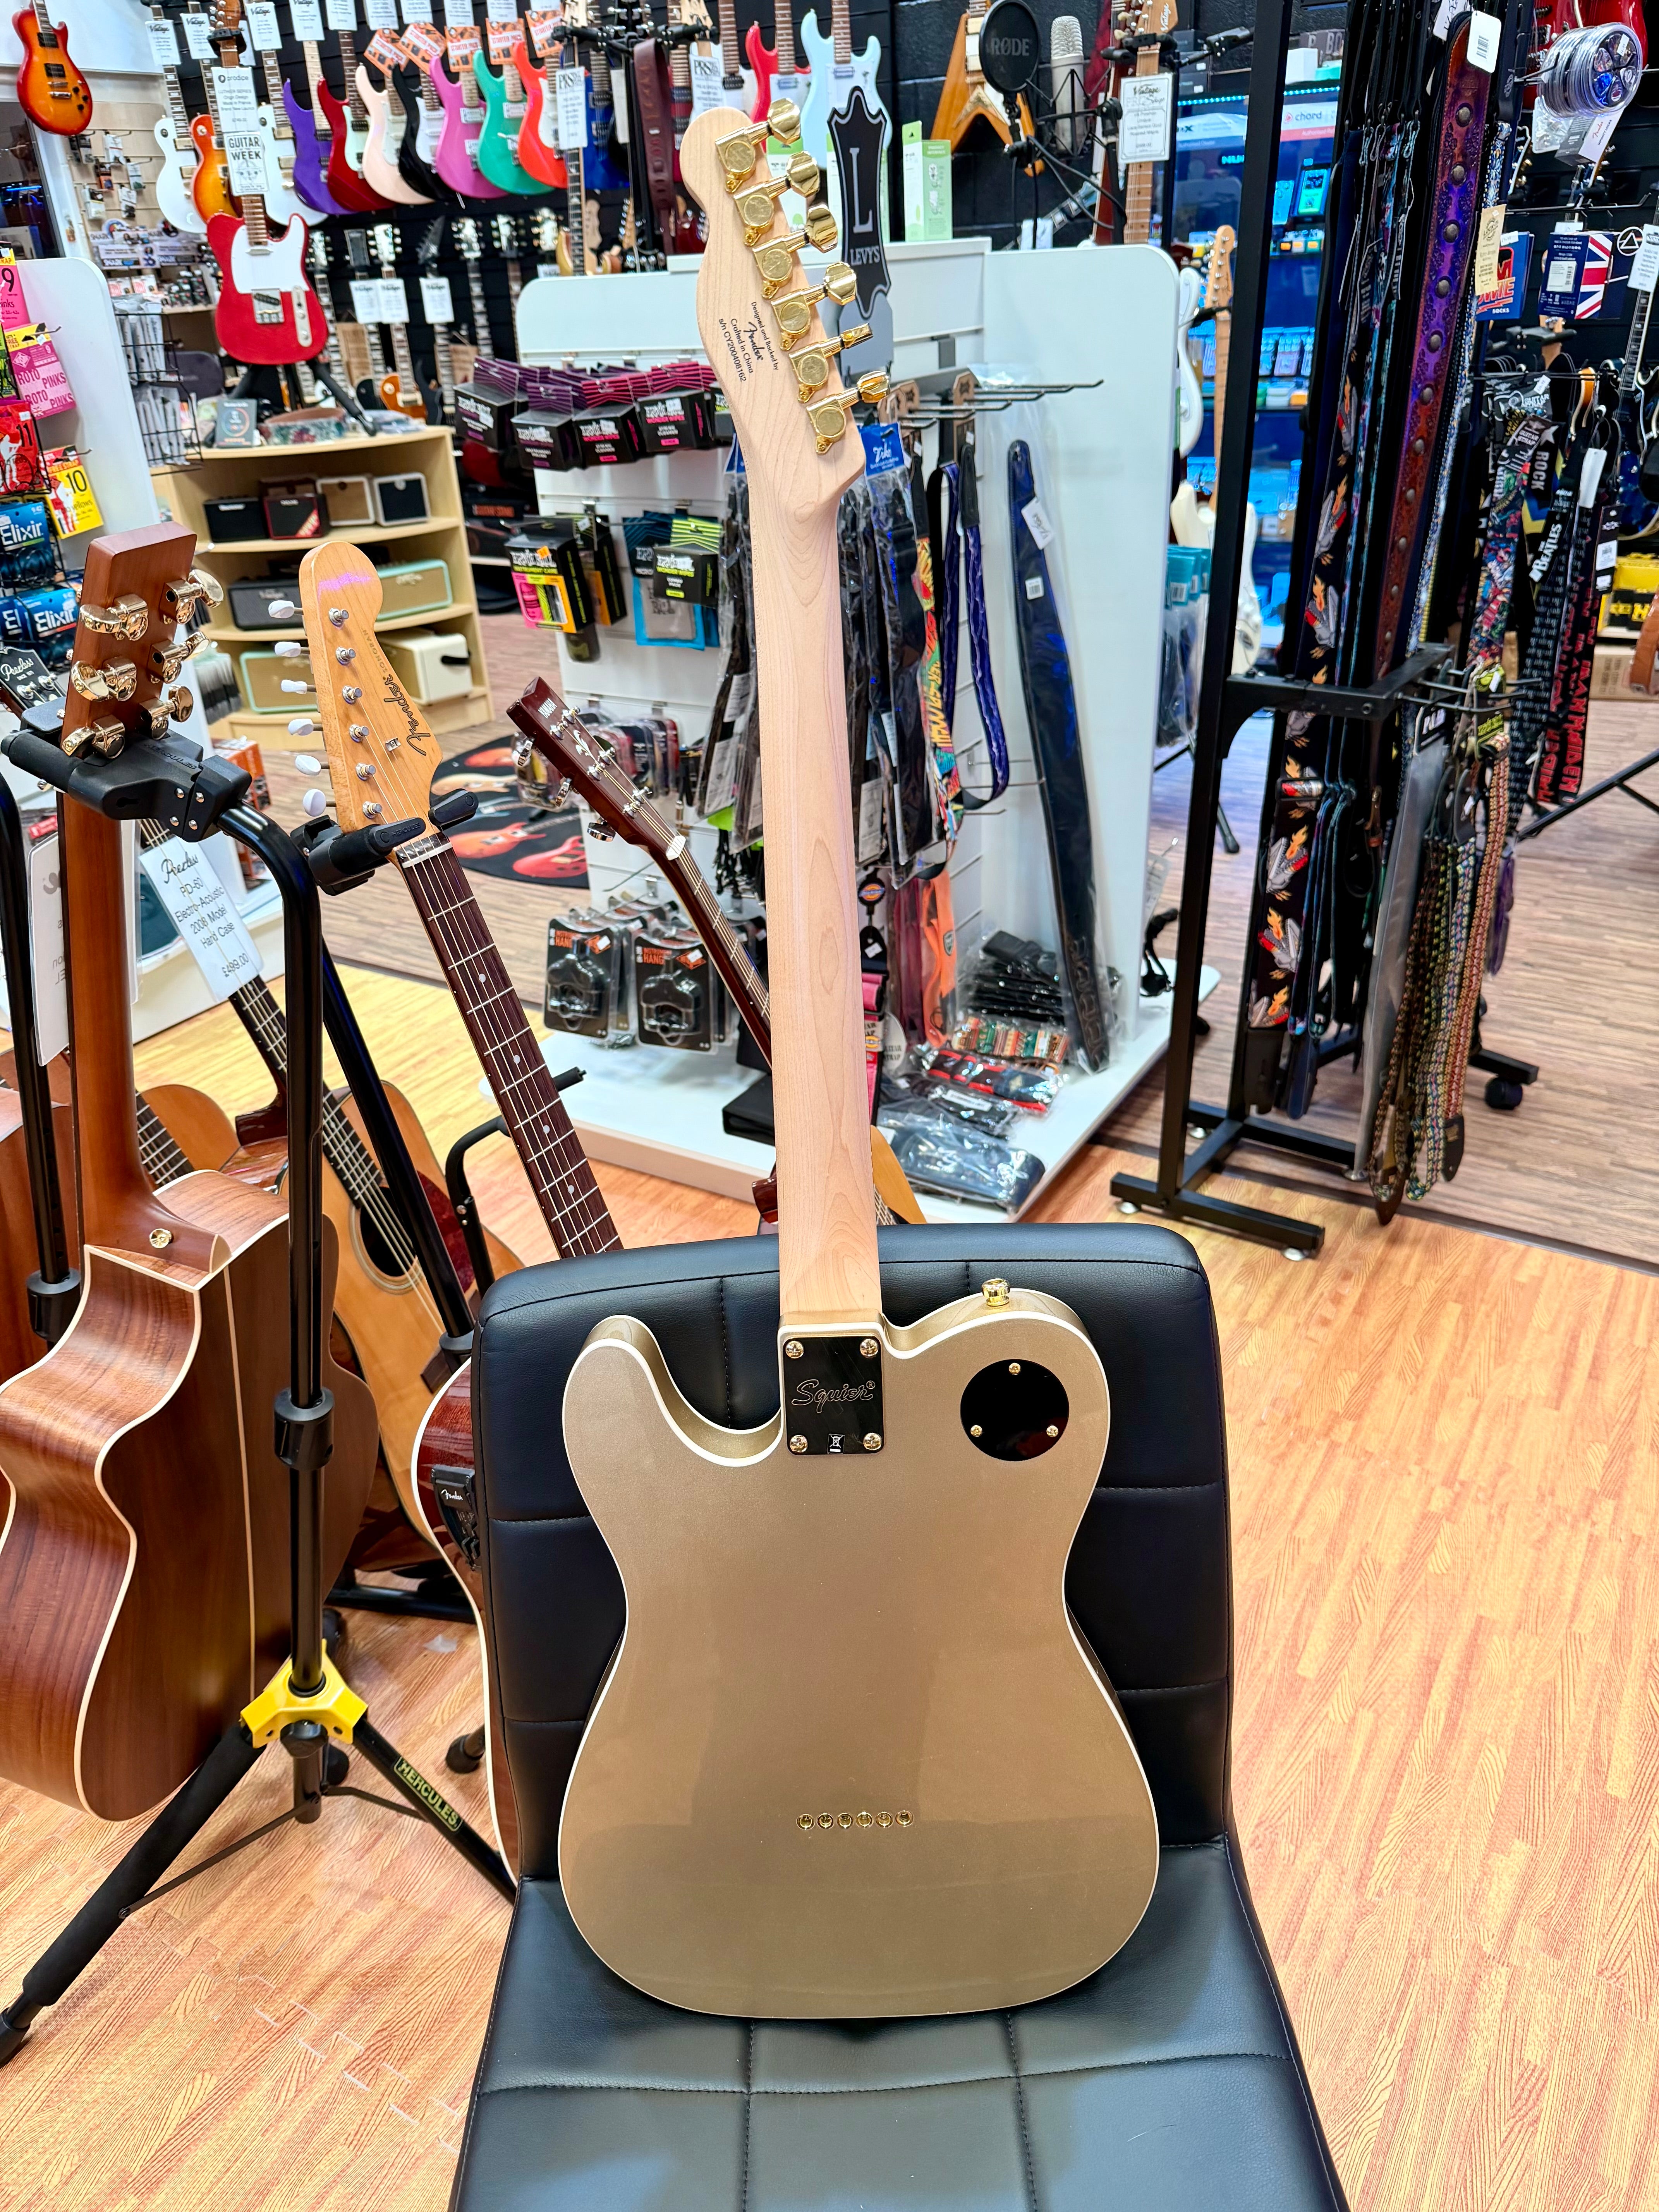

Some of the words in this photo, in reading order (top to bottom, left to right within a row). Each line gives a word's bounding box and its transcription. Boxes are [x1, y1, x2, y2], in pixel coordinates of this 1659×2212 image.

[991, 38, 1029, 56] RØDE
[1295, 111, 1322, 121] chord
[229, 137, 260, 148] GUITAR
[231, 151, 261, 160] WEEK
[849, 148, 873, 233] L
[850, 246, 880, 266] LEVY'S
[2, 268, 14, 292] 9
[731, 318, 745, 345] Crafted
[743, 353, 753, 373] China
[744, 321, 764, 361] Fender
[751, 302, 766, 328] Designed
[761, 329, 769, 341] and
[766, 341, 778, 362] Backed
[773, 362, 779, 370] by
[45, 345, 51, 354] 9
[719, 318, 727, 331] s/n
[724, 331, 746, 382] CY200408162
[17, 369, 40, 385] ROTO
[42, 372, 67, 389] PINKS
[25, 390, 48, 405] ROTO
[49, 393, 74, 408] PINKS
[16, 423, 33, 447] 11
[66, 470, 87, 494] 10
[1531, 451, 1549, 491] ROCK
[0, 521, 44, 544] Elixir
[1532, 524, 1562, 571] BEATLES
[34, 609, 74, 632] Elixir
[0, 658, 34, 682] Peerless
[383, 674, 431, 756] Fender
[538, 698, 557, 719] YAMAHA
[161, 852, 199, 884] Peerless
[175, 886, 225, 922] Electro-Acoustic
[206, 903, 228, 923] Model
[216, 921, 236, 938] Case
[398, 1760, 459, 1826] HERCULES
